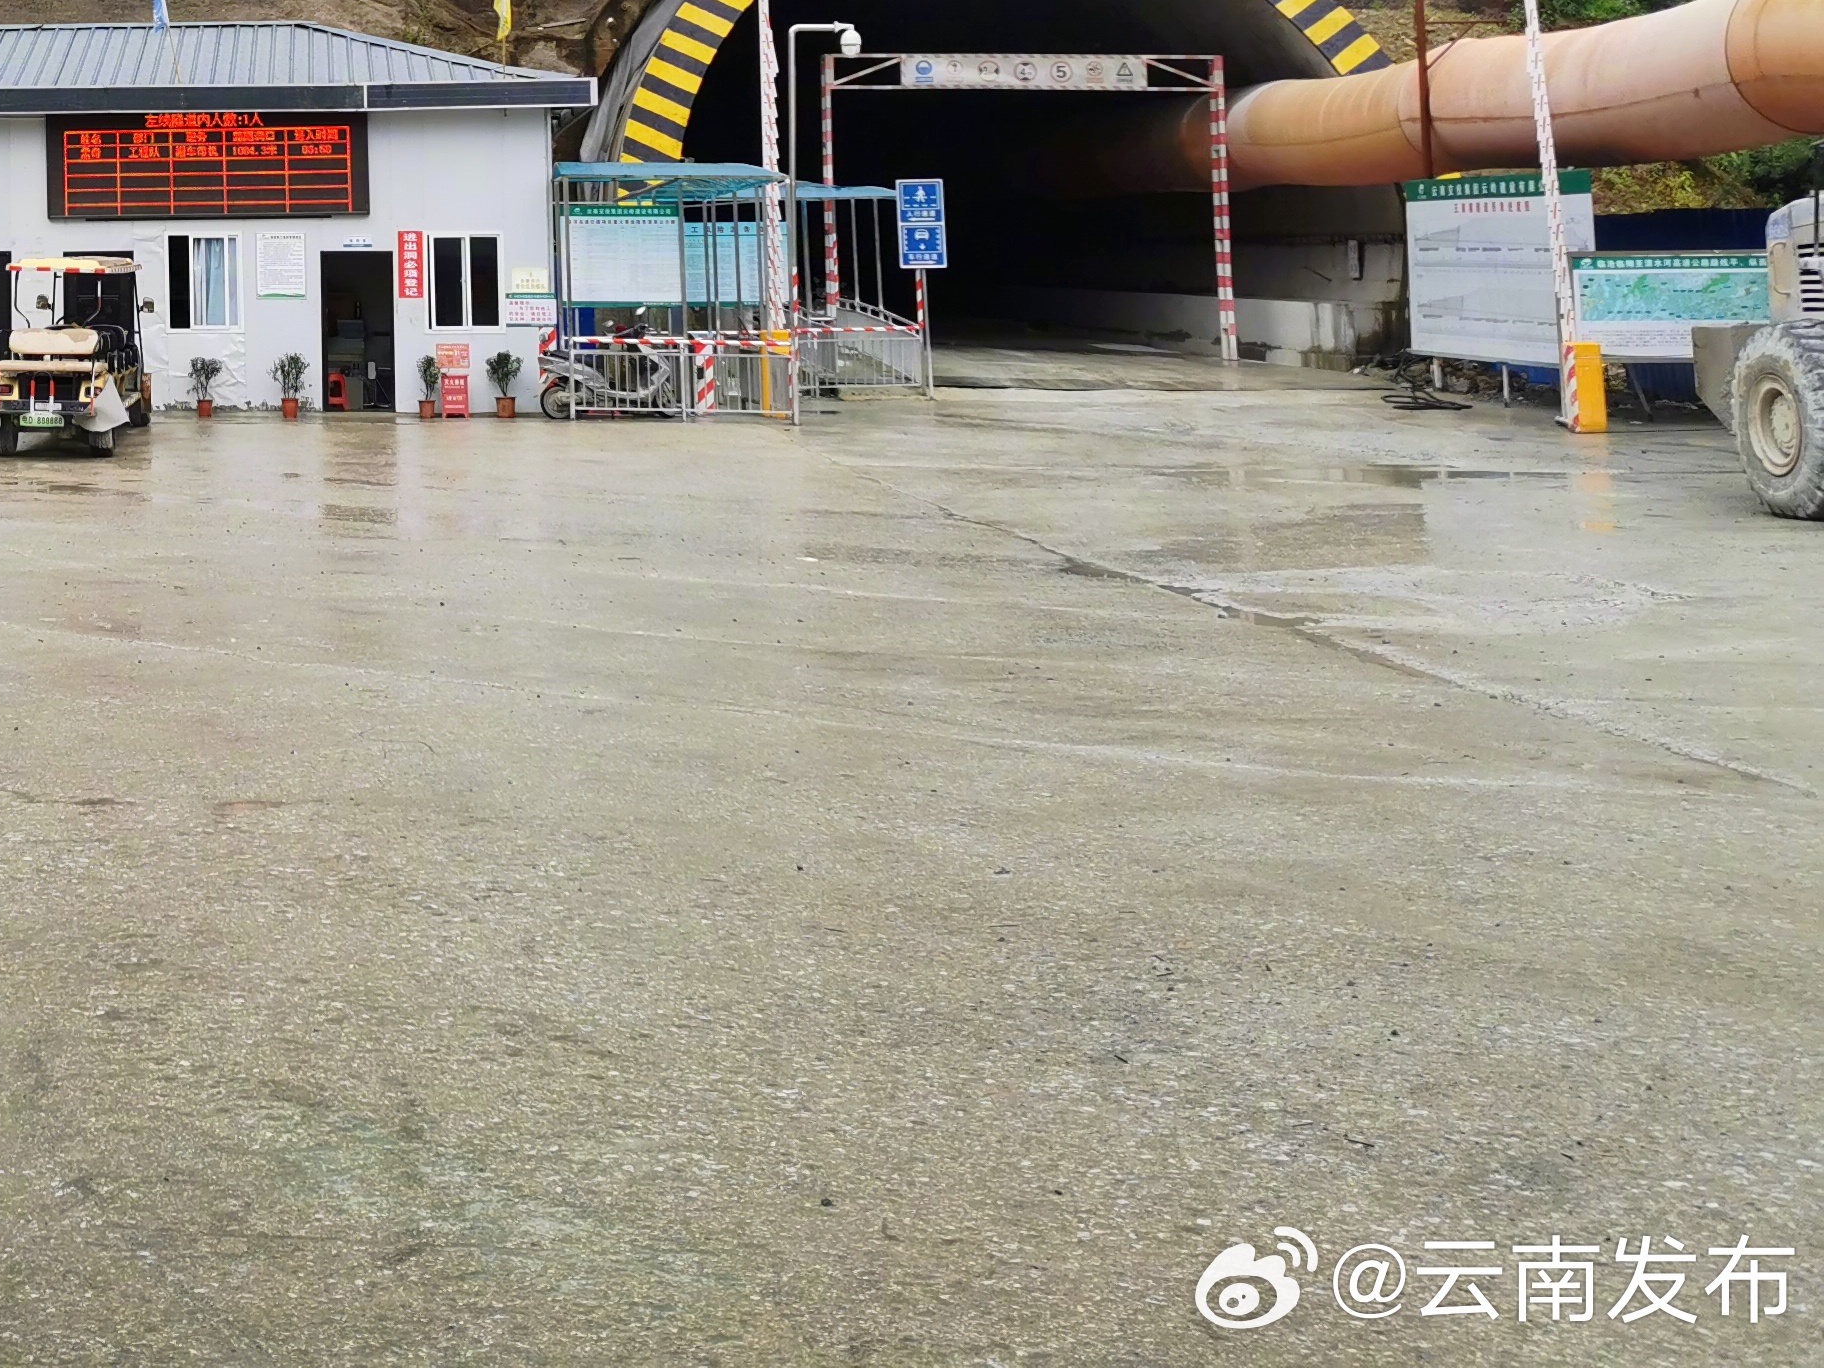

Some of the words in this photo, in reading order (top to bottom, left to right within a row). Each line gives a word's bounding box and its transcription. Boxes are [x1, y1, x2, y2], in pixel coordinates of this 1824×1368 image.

[1056, 65, 1068, 79] 5
[402, 232, 419, 297] 进出洞必须登记
